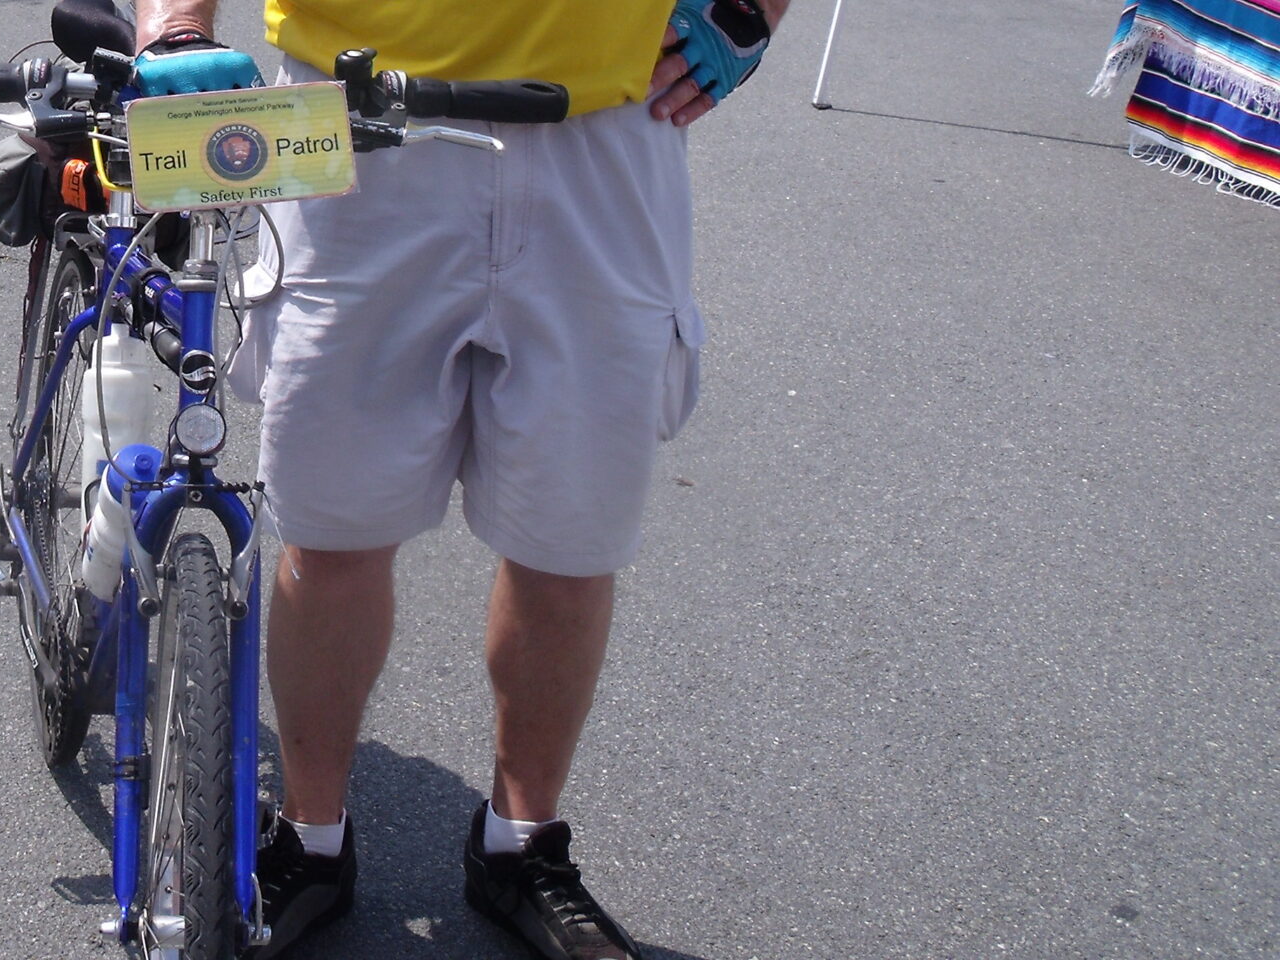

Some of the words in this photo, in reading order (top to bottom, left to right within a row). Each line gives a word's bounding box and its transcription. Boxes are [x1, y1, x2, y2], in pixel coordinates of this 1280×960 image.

[167, 111, 193, 120] George
[194, 108, 233, 118] Washington
[234, 104, 265, 113] Memorial
[266, 103, 295, 111] Parkway
[211, 125, 258, 142] VOLUNTEER
[276, 133, 339, 157] Patrol
[139, 150, 187, 172] Trail
[200, 189, 245, 205] Safety
[250, 187, 283, 200] First
